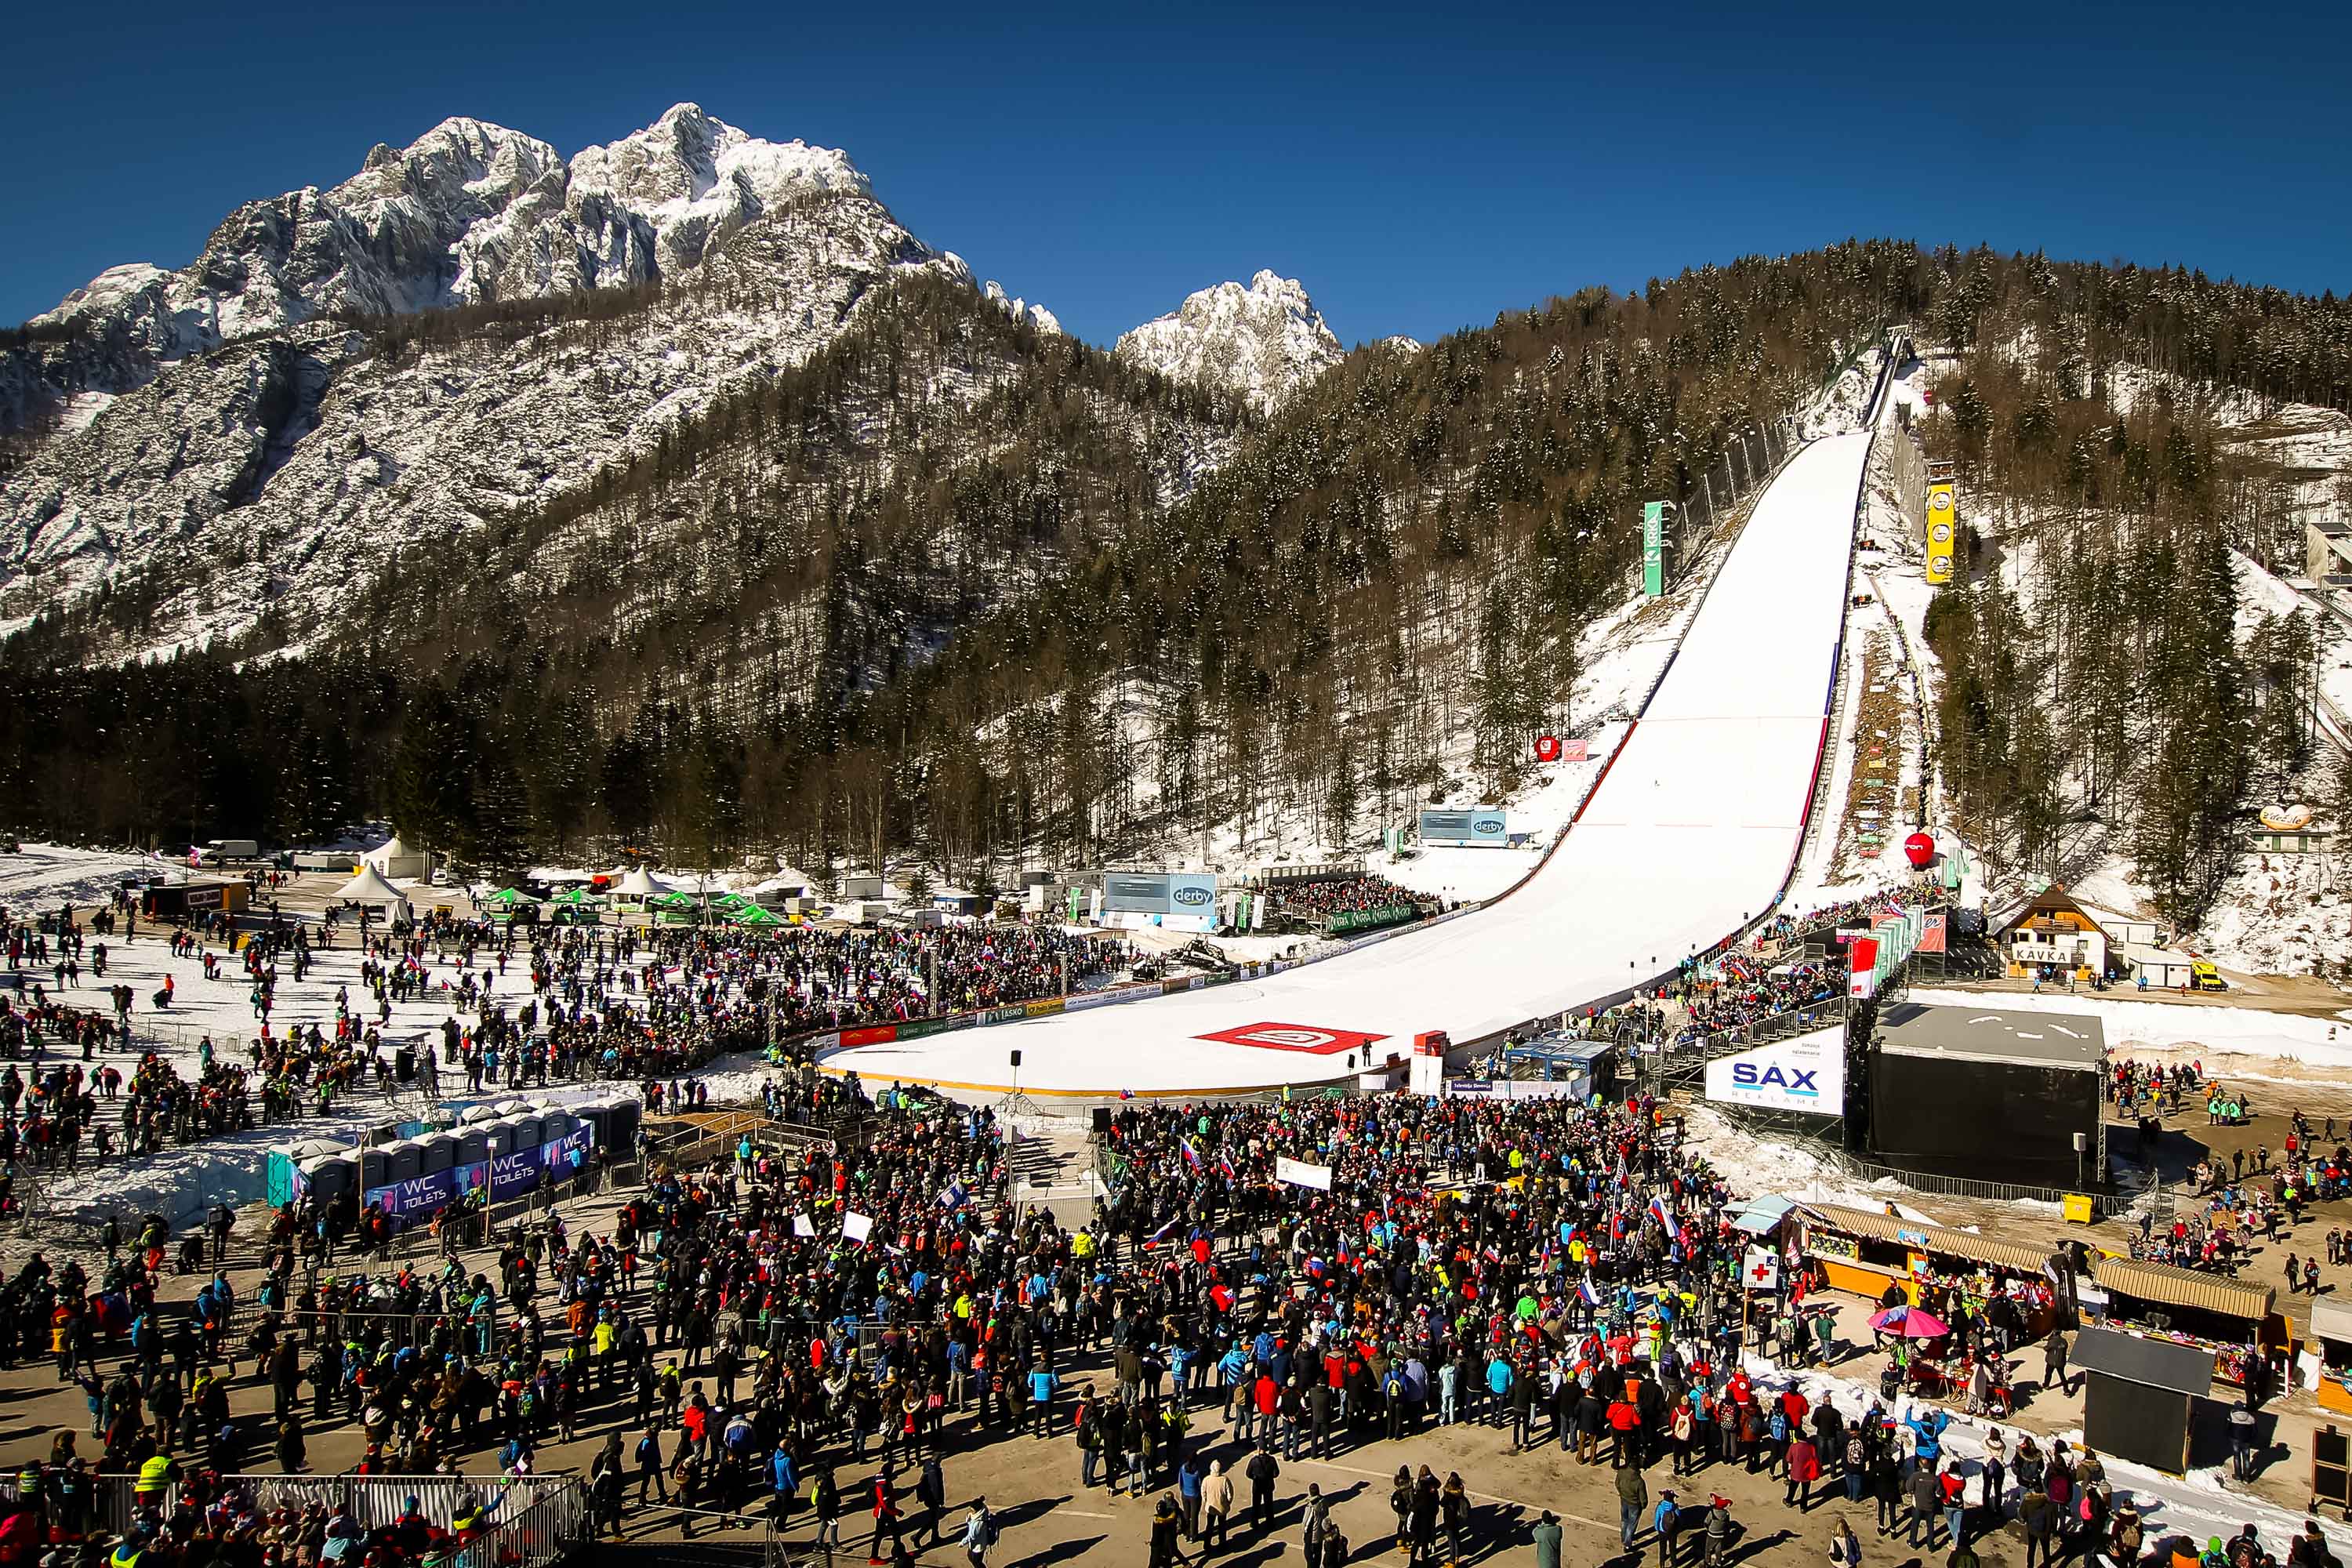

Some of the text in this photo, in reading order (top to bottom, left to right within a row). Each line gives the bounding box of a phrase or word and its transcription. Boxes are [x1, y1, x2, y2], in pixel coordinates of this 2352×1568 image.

[1647, 513, 1659, 546] KRKA
[1475, 820, 1504, 833] derby
[1175, 887, 1211, 906] derby
[2016, 949, 2067, 962] KAVKA
[1733, 1062, 1818, 1091] SAX
[564, 1131, 582, 1150] WC
[492, 1152, 524, 1173] WC
[403, 1174, 435, 1196] WC
[492, 1166, 535, 1186] TOILETS
[403, 1189, 447, 1210] TOILETS
